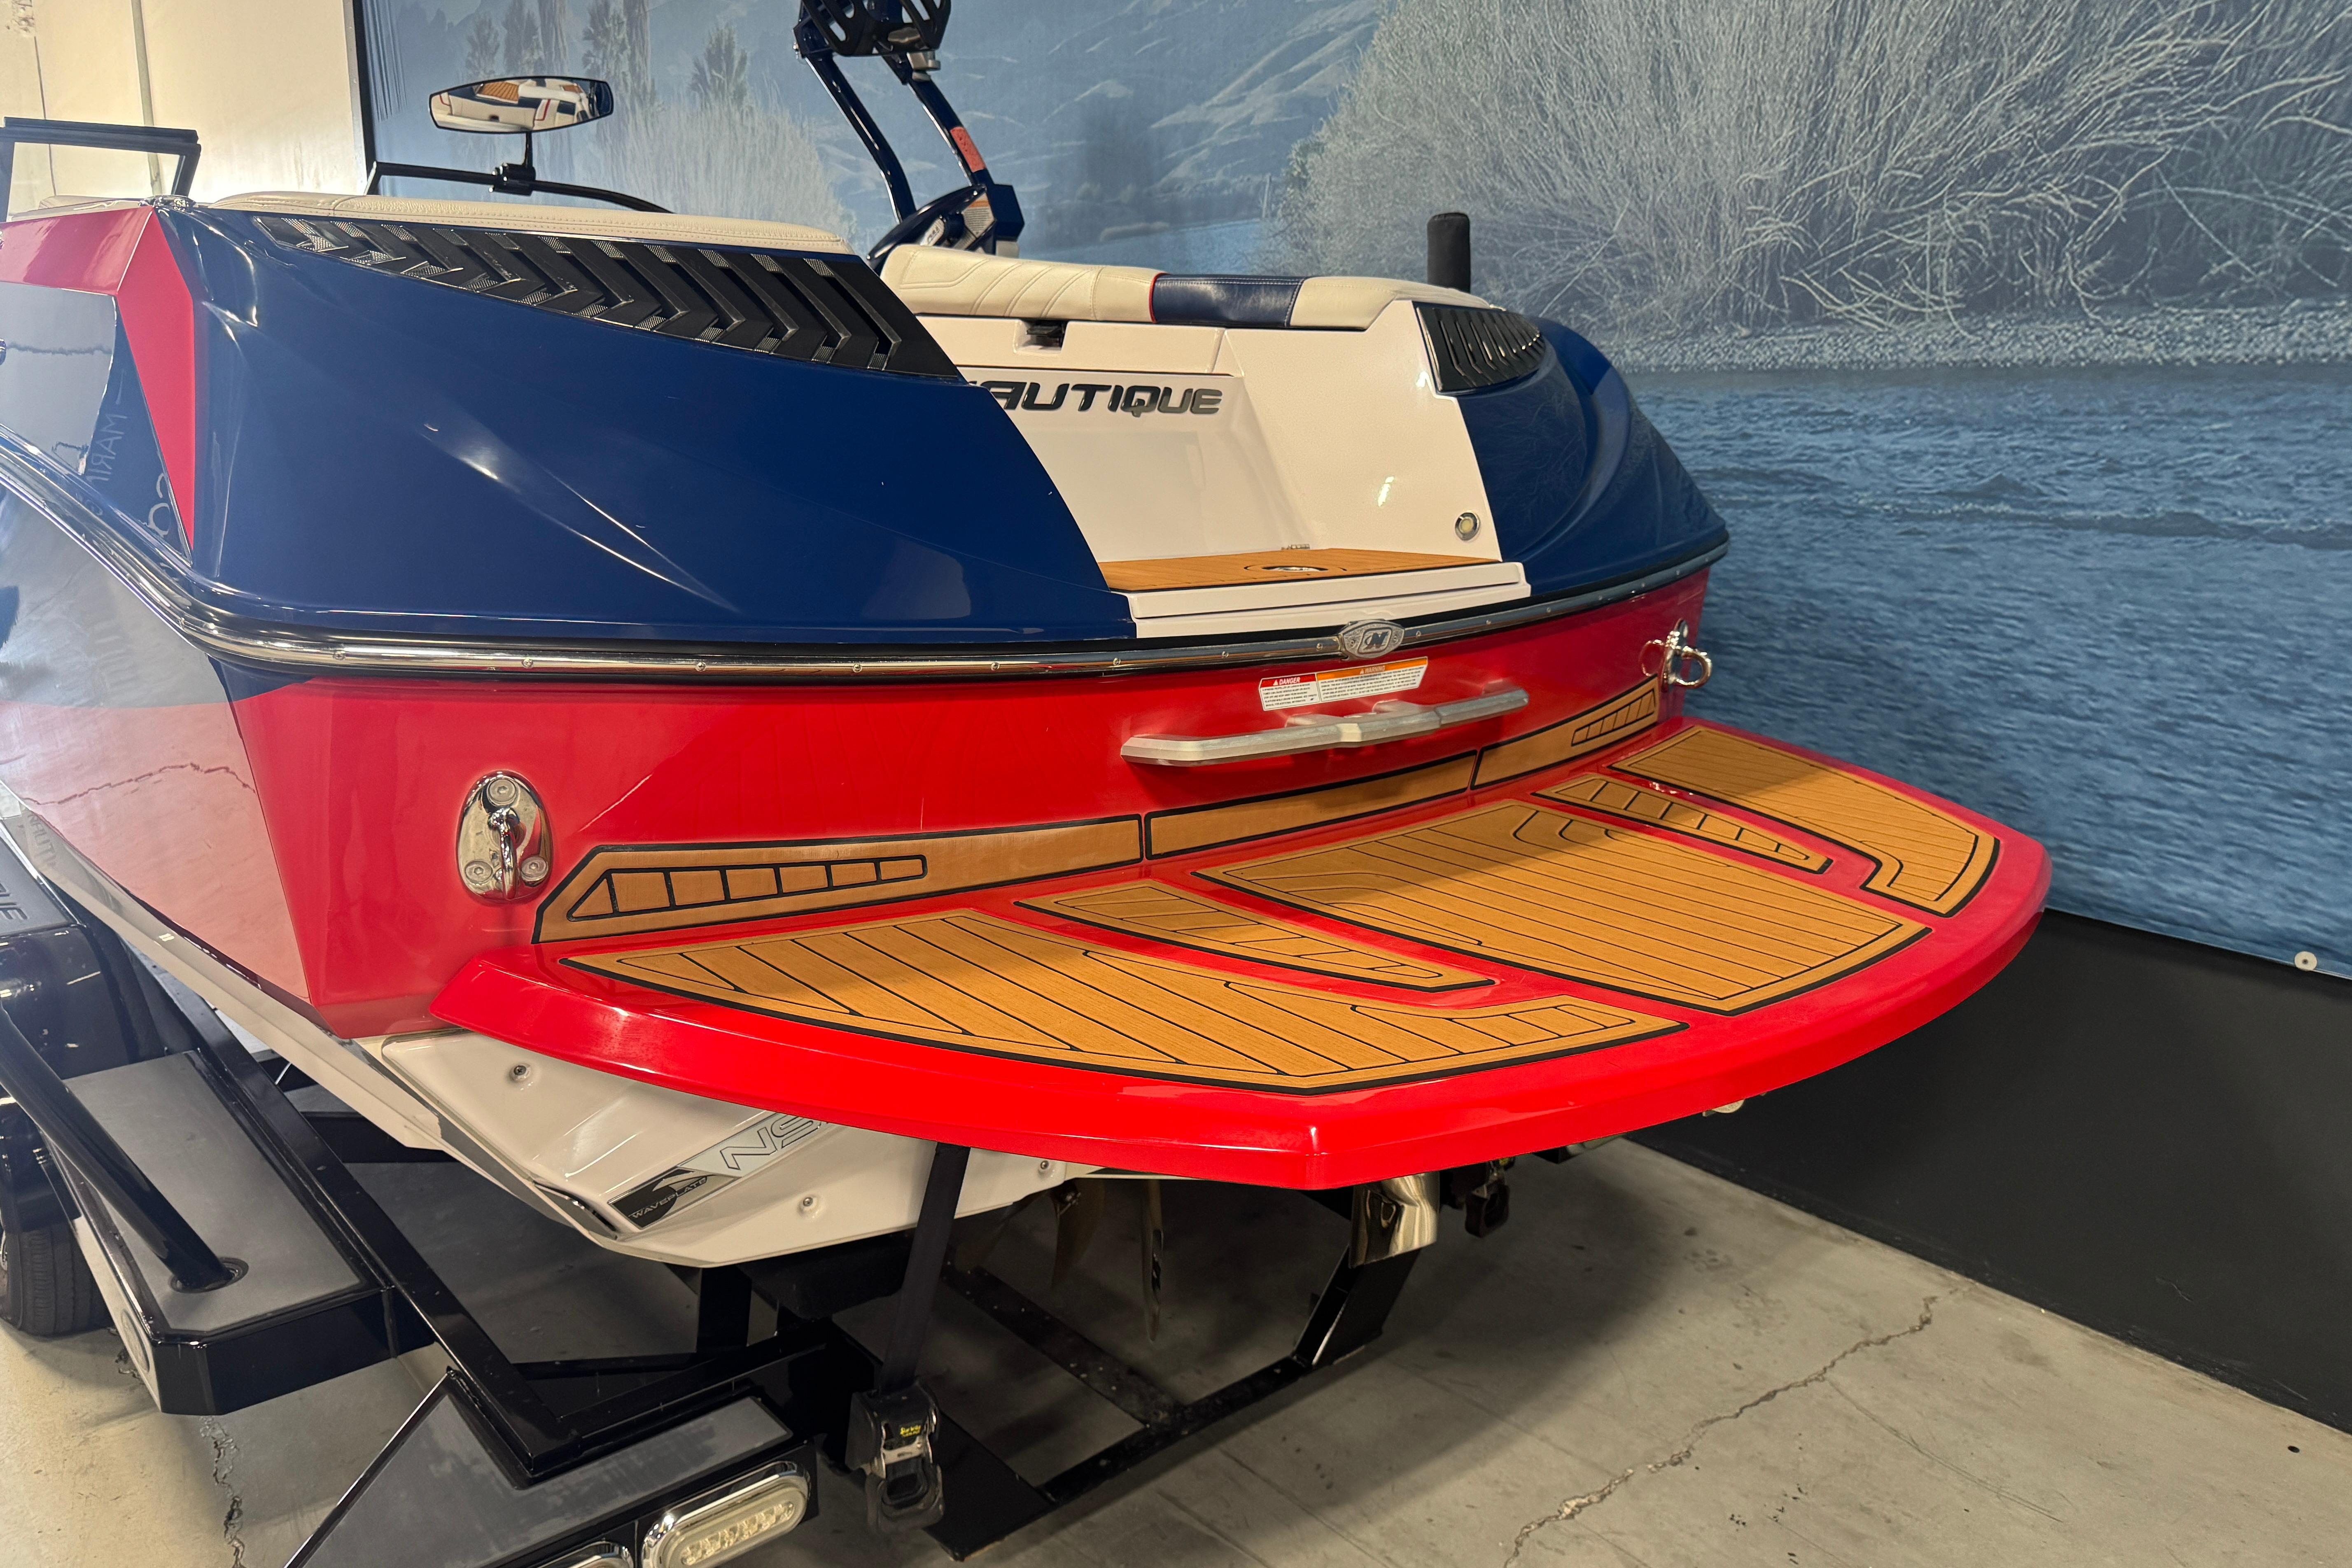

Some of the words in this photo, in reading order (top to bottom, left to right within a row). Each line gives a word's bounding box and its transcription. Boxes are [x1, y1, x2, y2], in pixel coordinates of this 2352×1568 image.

[970, 380, 1223, 417] AUTIQUE
[1279, 677, 1301, 686] DANGER
[1365, 665, 1385, 674] WARNING
[720, 1113, 828, 1170] NS
[632, 1176, 707, 1219] WAVEPLATE
